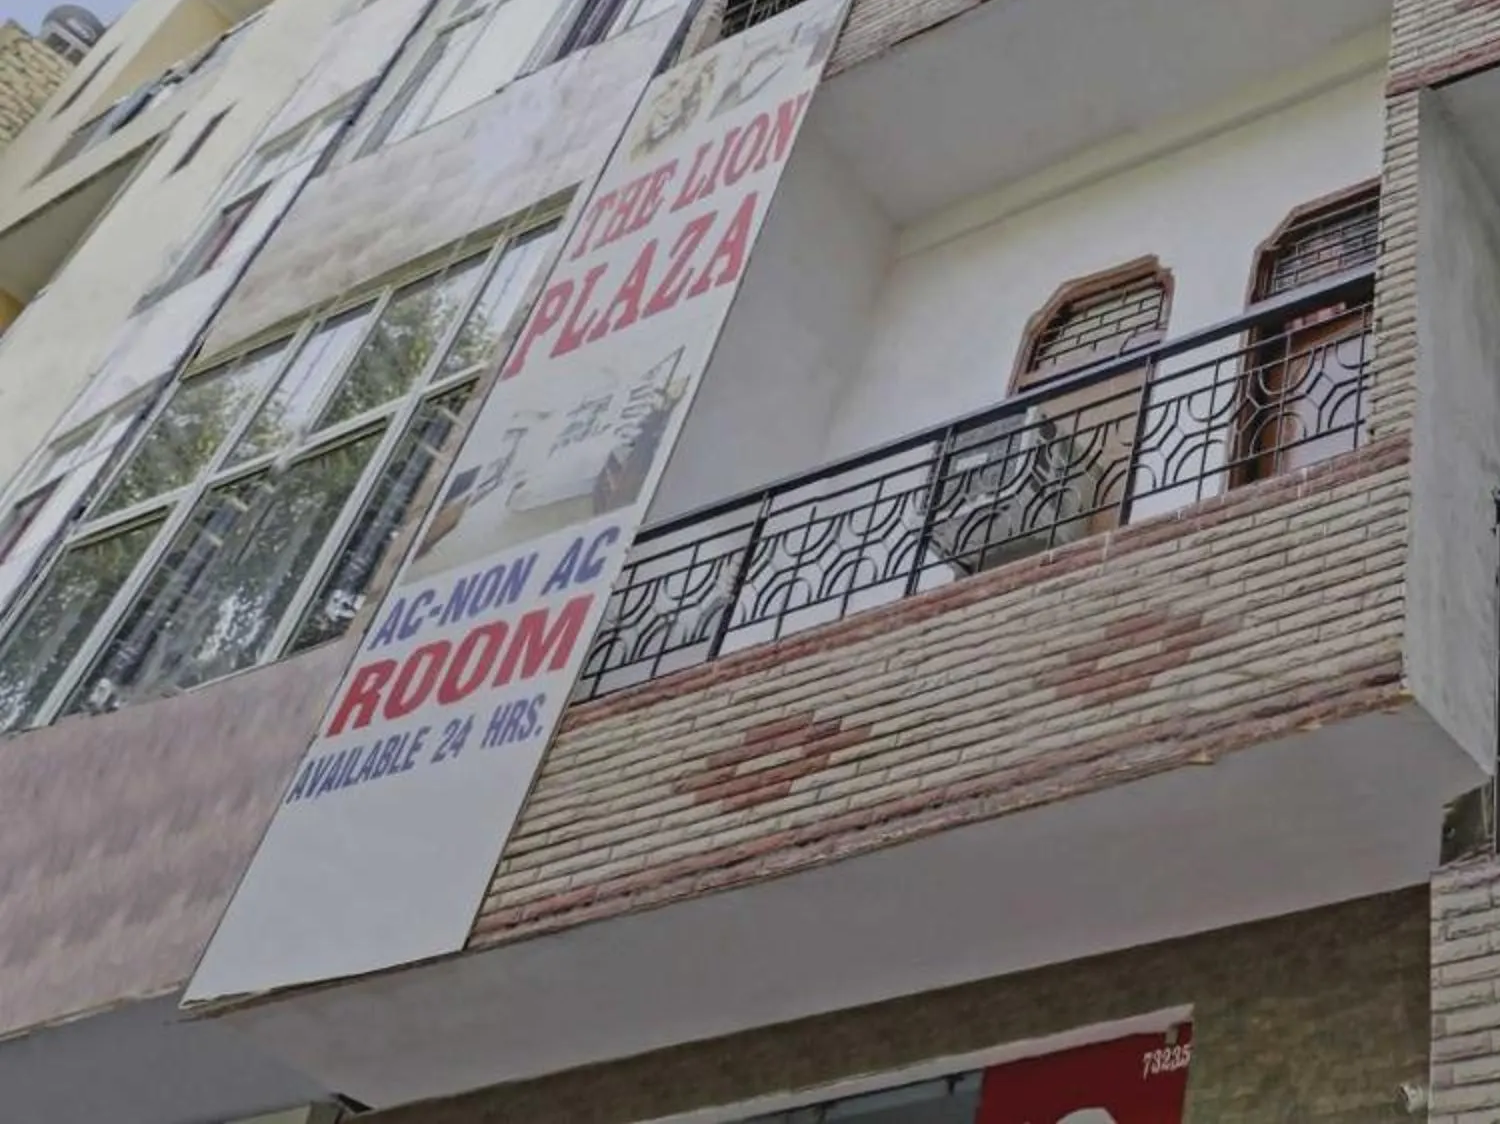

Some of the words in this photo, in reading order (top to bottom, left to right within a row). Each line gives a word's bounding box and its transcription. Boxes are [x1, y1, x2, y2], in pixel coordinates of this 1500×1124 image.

[569, 159, 678, 261] THE
[669, 89, 811, 213] LION
[501, 191, 758, 381] PLAZA
[367, 552, 539, 652] AC-NON
[541, 526, 621, 596] AC
[324, 593, 596, 738] ROOM
[286, 726, 431, 805] AVAILABLE
[431, 718, 474, 764] 24
